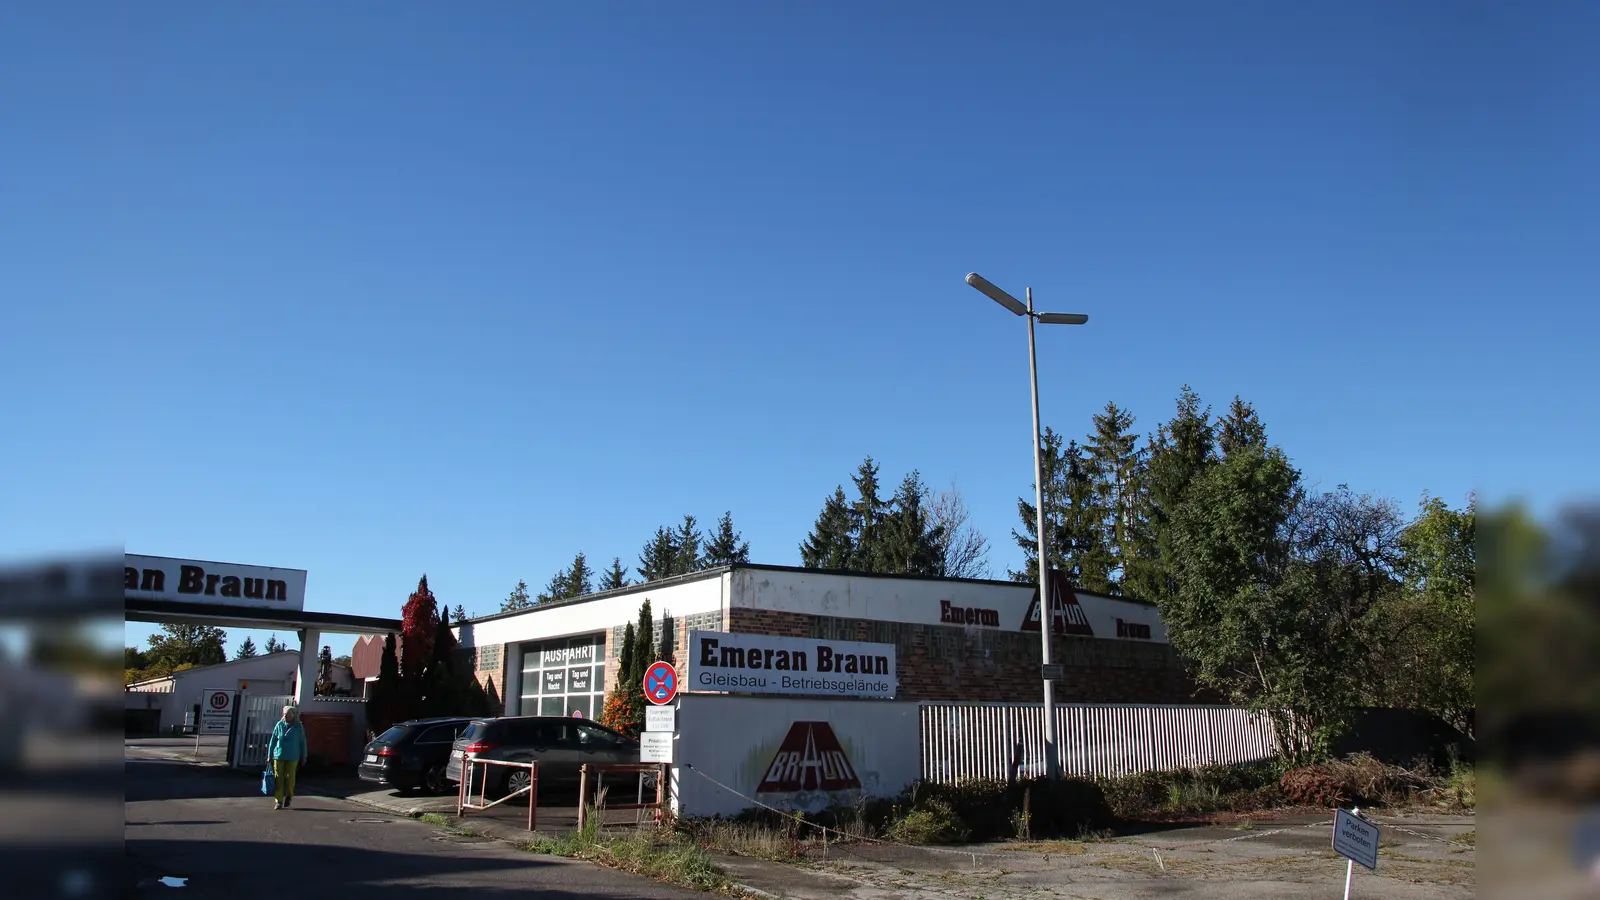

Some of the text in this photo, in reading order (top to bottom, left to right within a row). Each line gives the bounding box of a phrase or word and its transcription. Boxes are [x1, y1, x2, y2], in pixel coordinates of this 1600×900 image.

[178, 565, 287, 601] Braun
[1030, 576, 1087, 633] BAUN
[544, 645, 593, 662] AUSFAHRT
[700, 637, 889, 675] Emeran Braun
[546, 671, 563, 682] Tag und
[571, 669, 589, 680] Tag und
[699, 672, 767, 688] Gleisbau
[781, 676, 889, 694] Betriebsgelände
[547, 682, 560, 690] Nacht
[573, 681, 587, 689] Nacht
[214, 695, 225, 706] 10
[765, 723, 854, 789] BRAUN
[1345, 818, 1370, 837] Parken
[1341, 828, 1371, 848] verboten
